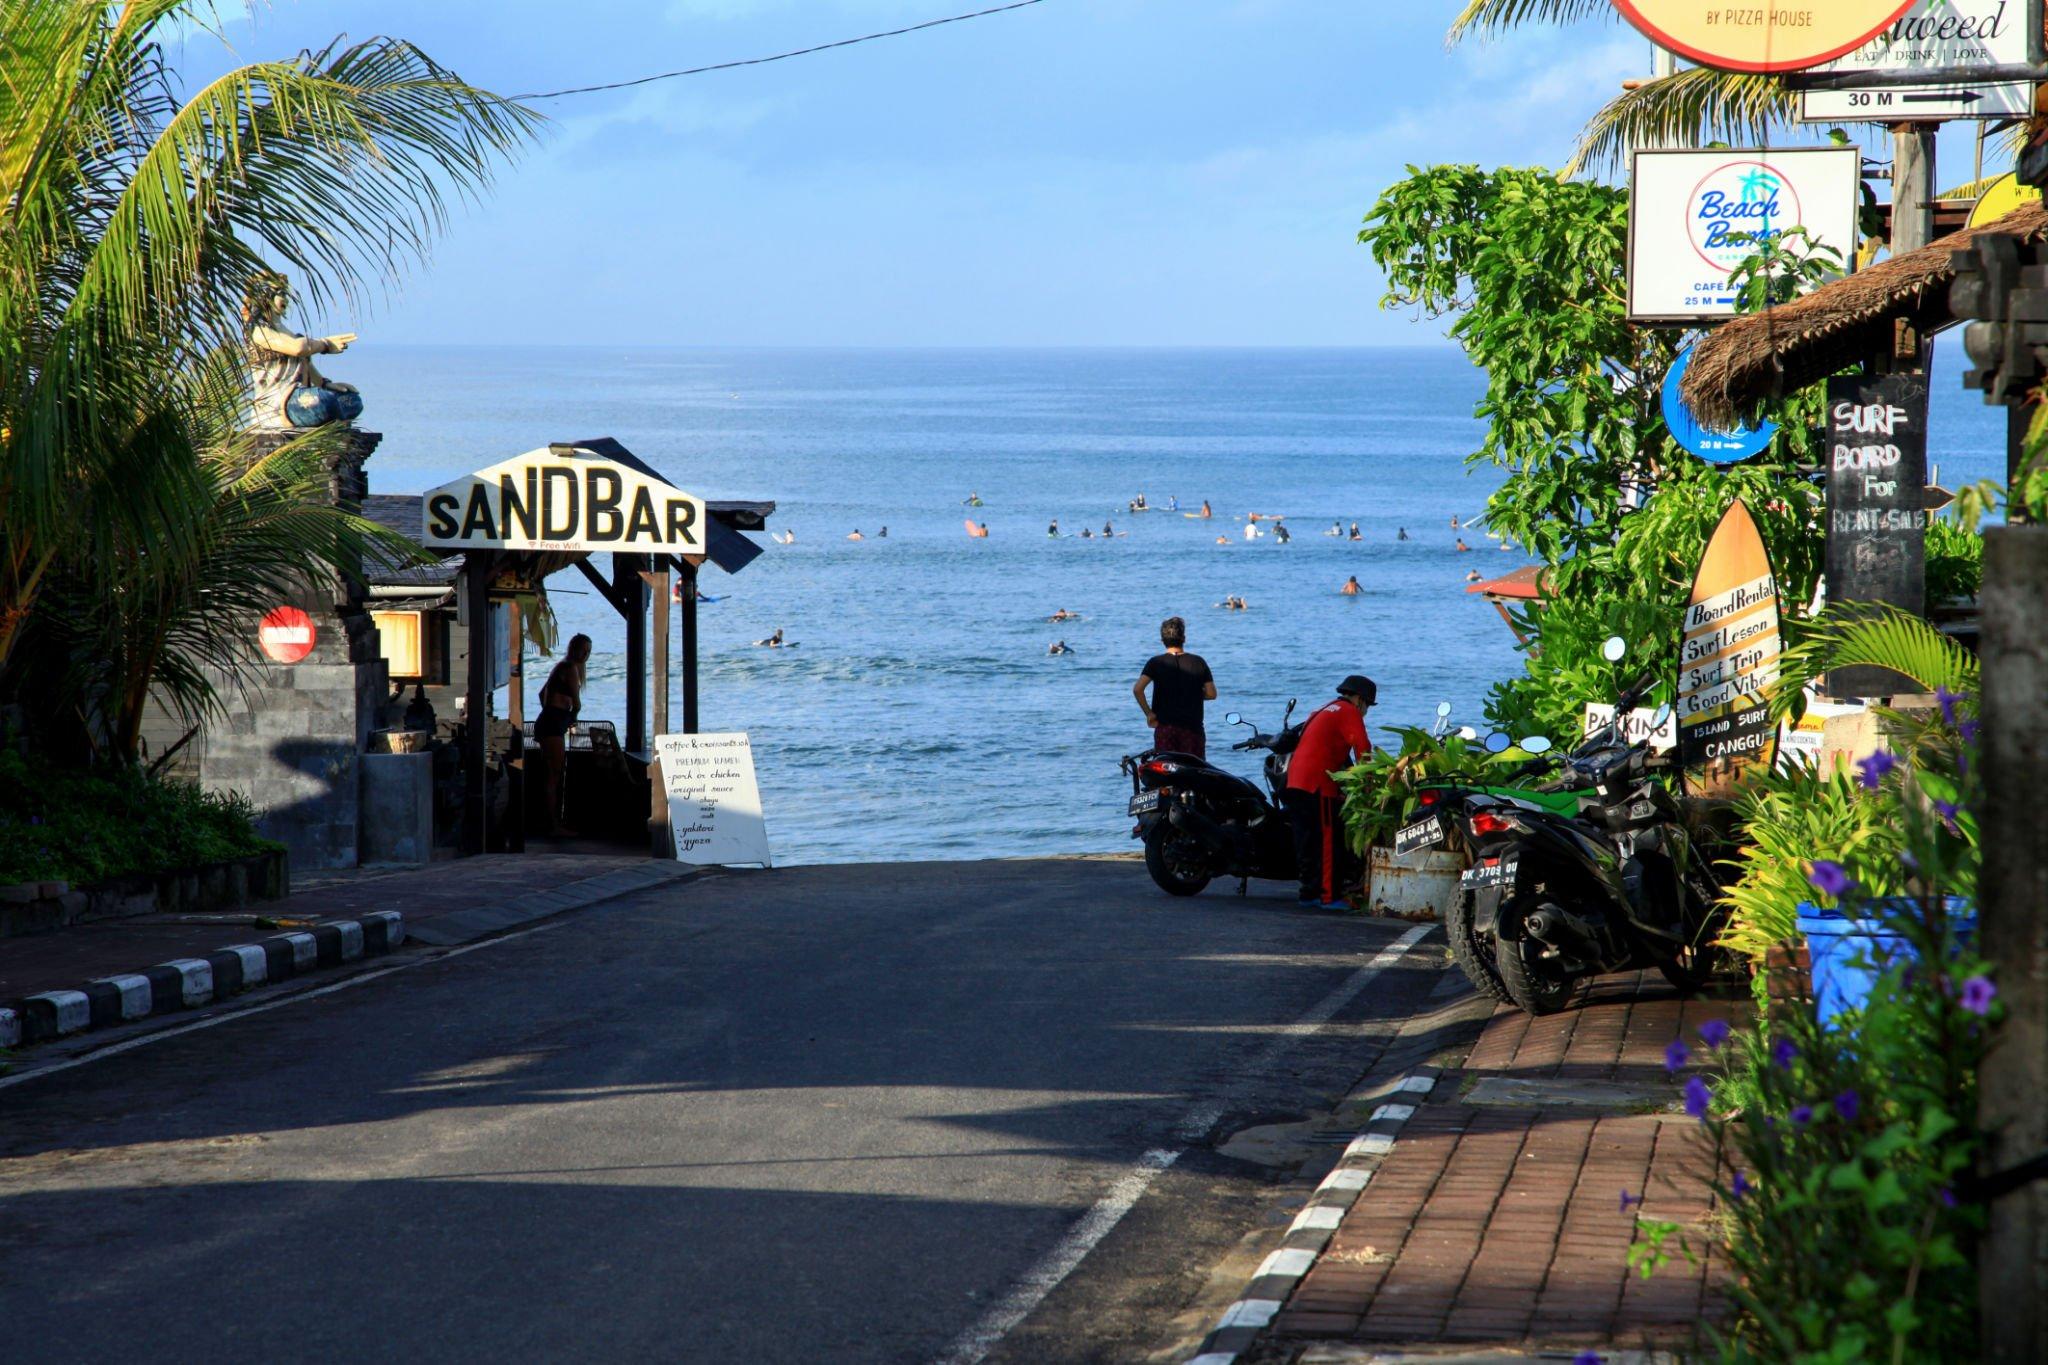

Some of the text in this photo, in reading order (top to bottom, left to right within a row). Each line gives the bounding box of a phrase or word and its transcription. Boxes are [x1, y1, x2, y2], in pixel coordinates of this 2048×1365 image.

[1706, 9, 1813, 27] BY PIZZA HOUSE
[1854, 48, 1987, 62] EAT DRINK LOVE
[1848, 92, 1893, 106] 30 M
[1698, 187, 1781, 219] Beach
[1693, 280, 1724, 291] CAFÉ
[1684, 296, 1712, 305] 25 M
[1833, 402, 1908, 435] SURF
[1699, 440, 1722, 449] 20 M
[1833, 444, 1902, 472] BOARD
[428, 465, 698, 545] SANDBAR
[1832, 508, 1881, 534] RENT
[1692, 577, 1775, 626] Board Rental
[1688, 620, 1767, 660] Surf Lesson
[1690, 649, 1763, 688] Surf Trip
[1687, 673, 1767, 713] Good Vibe
[1694, 709, 1767, 738] ISLAND SURF
[1705, 732, 1765, 758] CANGGU
[710, 769, 741, 779] chicken
[1461, 869, 1476, 881] DK
